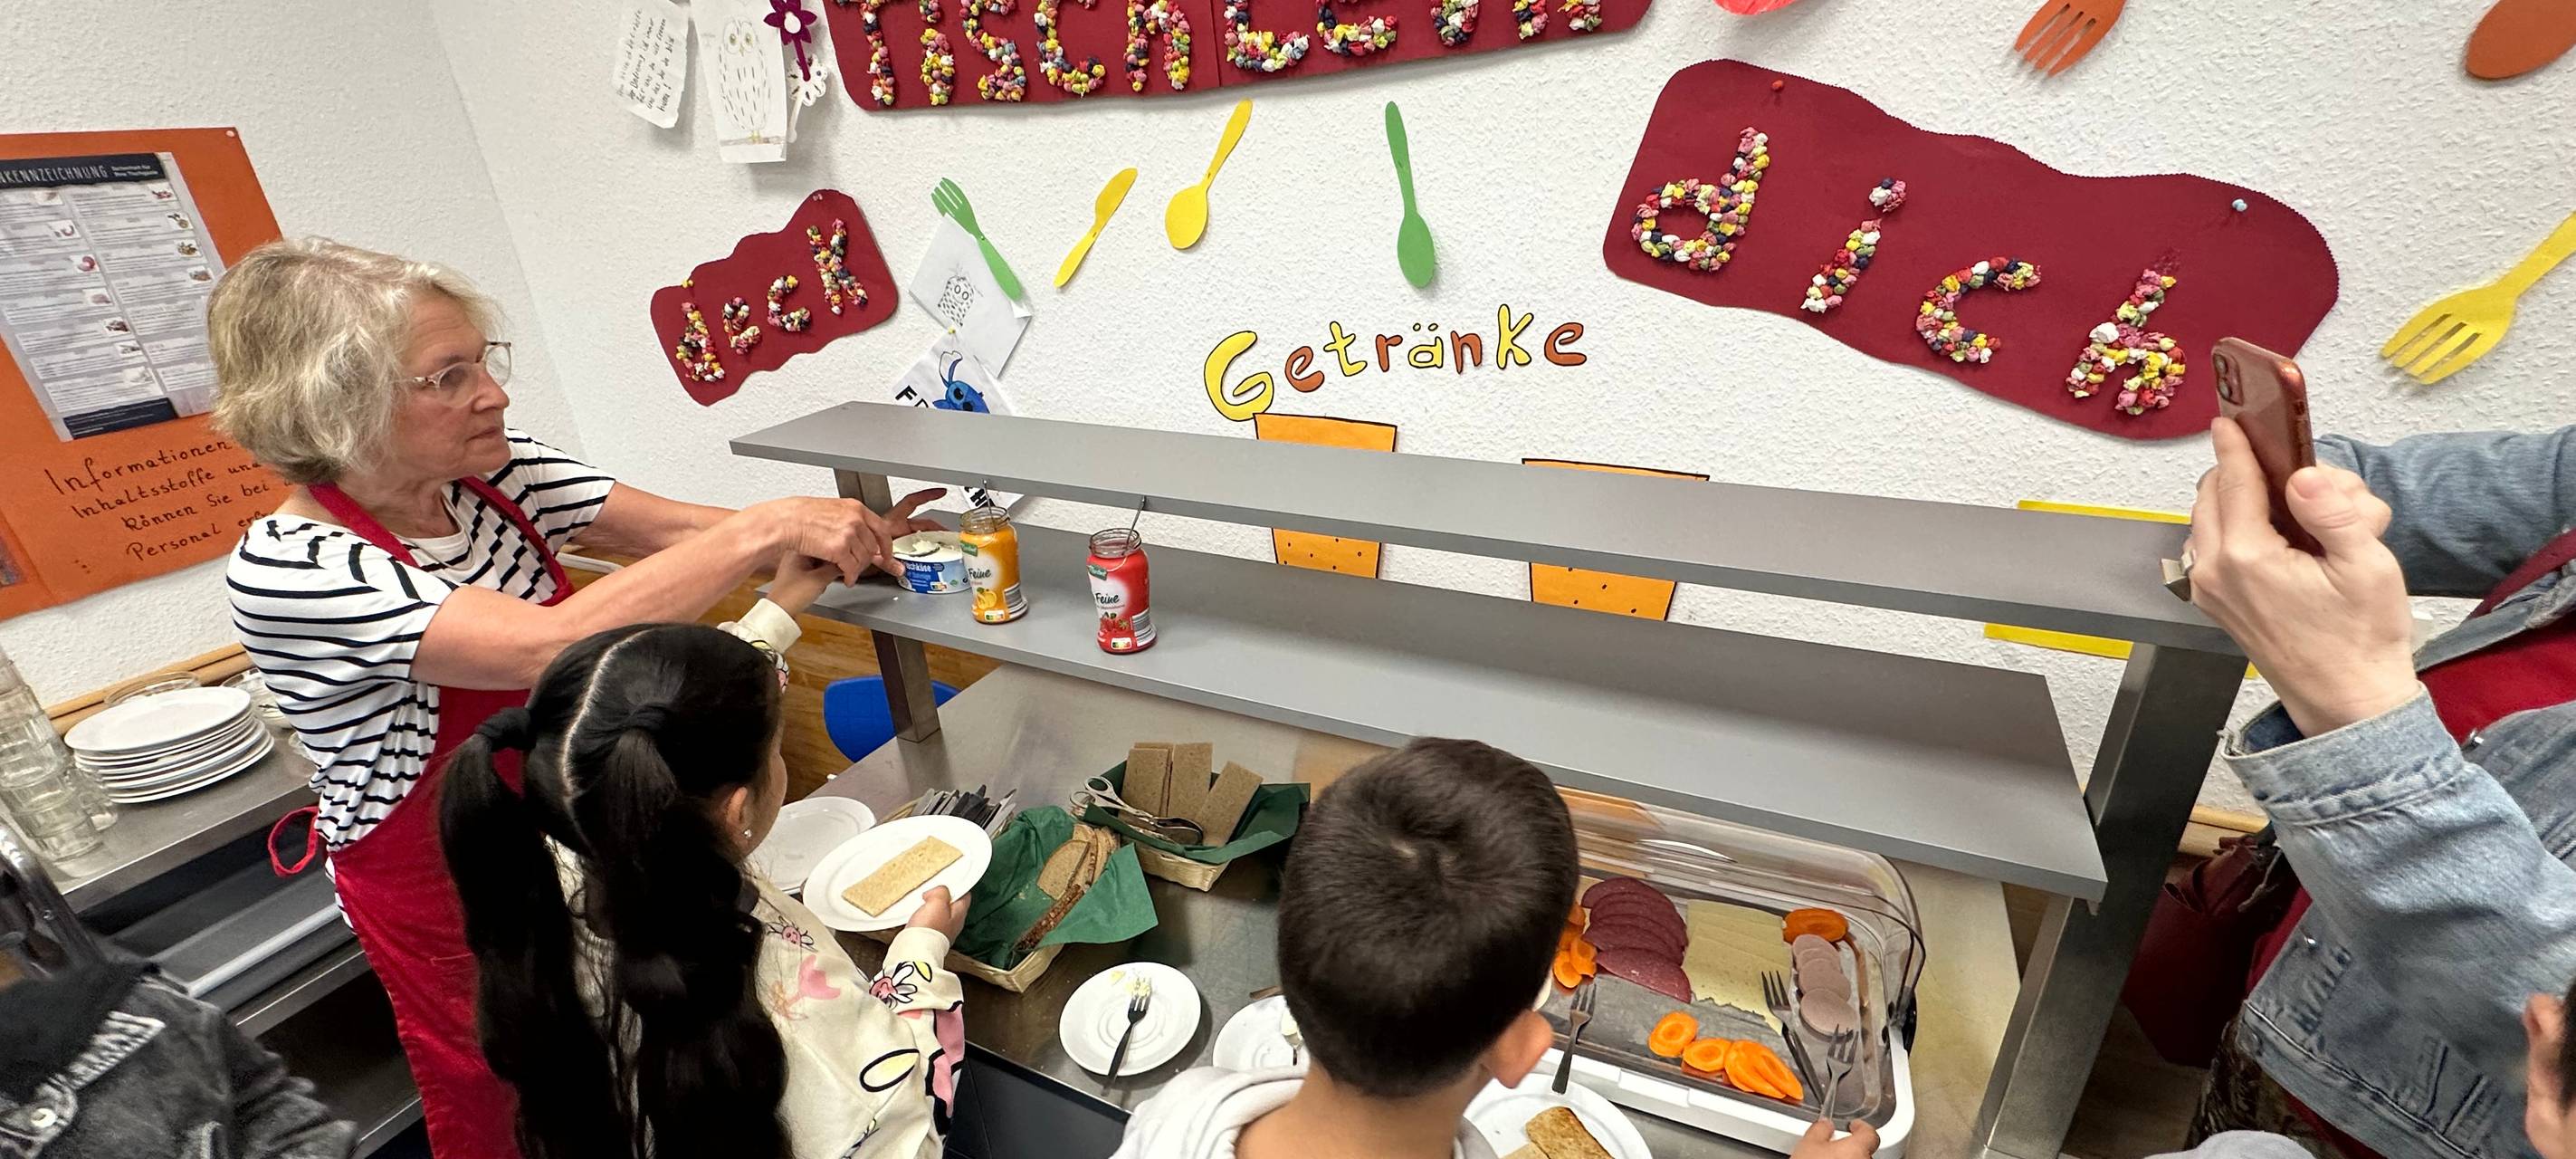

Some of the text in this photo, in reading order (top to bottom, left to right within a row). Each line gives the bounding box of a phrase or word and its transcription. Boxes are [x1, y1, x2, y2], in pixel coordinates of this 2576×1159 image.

[1631, 125, 2187, 416] dich
[675, 218, 868, 382] deck
[1204, 303, 1588, 422] Getränke
[45, 440, 232, 494] Informationen
[72, 467, 215, 519] Inhaltsstoffe
[209, 493, 233, 507] Sie
[241, 480, 270, 497] bei
[126, 523, 222, 561] Personal
[968, 568, 992, 580] Feine
[1095, 593, 1120, 605] Feine
